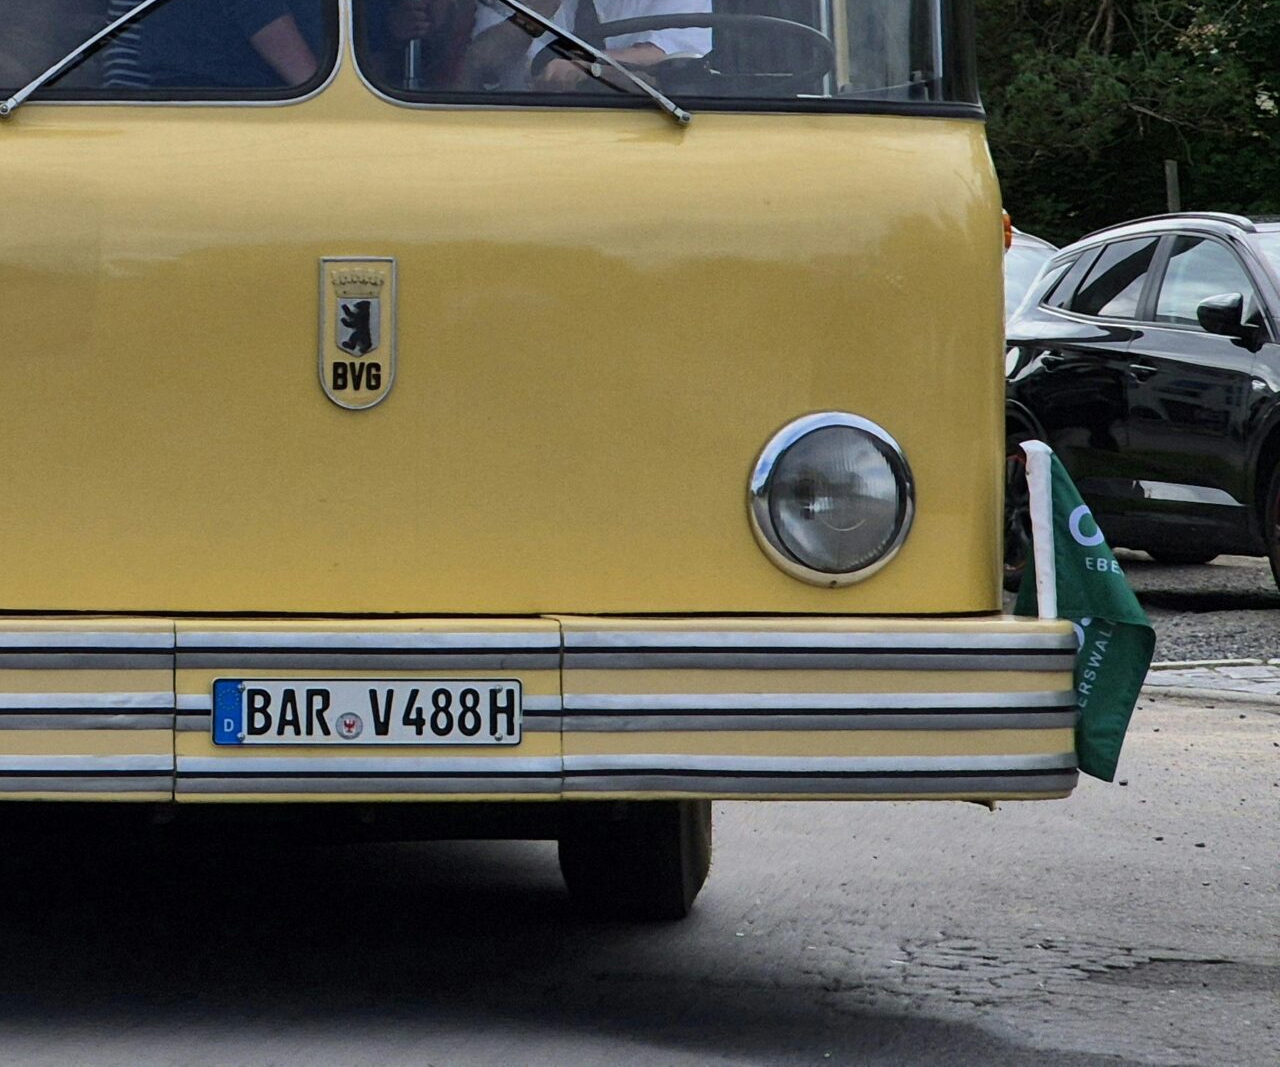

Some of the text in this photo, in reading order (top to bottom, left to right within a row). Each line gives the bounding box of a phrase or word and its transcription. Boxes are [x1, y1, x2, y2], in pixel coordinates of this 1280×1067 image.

[332, 361, 382, 391] BVG
[1085, 557, 1125, 578] EBE
[223, 718, 234, 732] D
[246, 688, 331, 736] BAR
